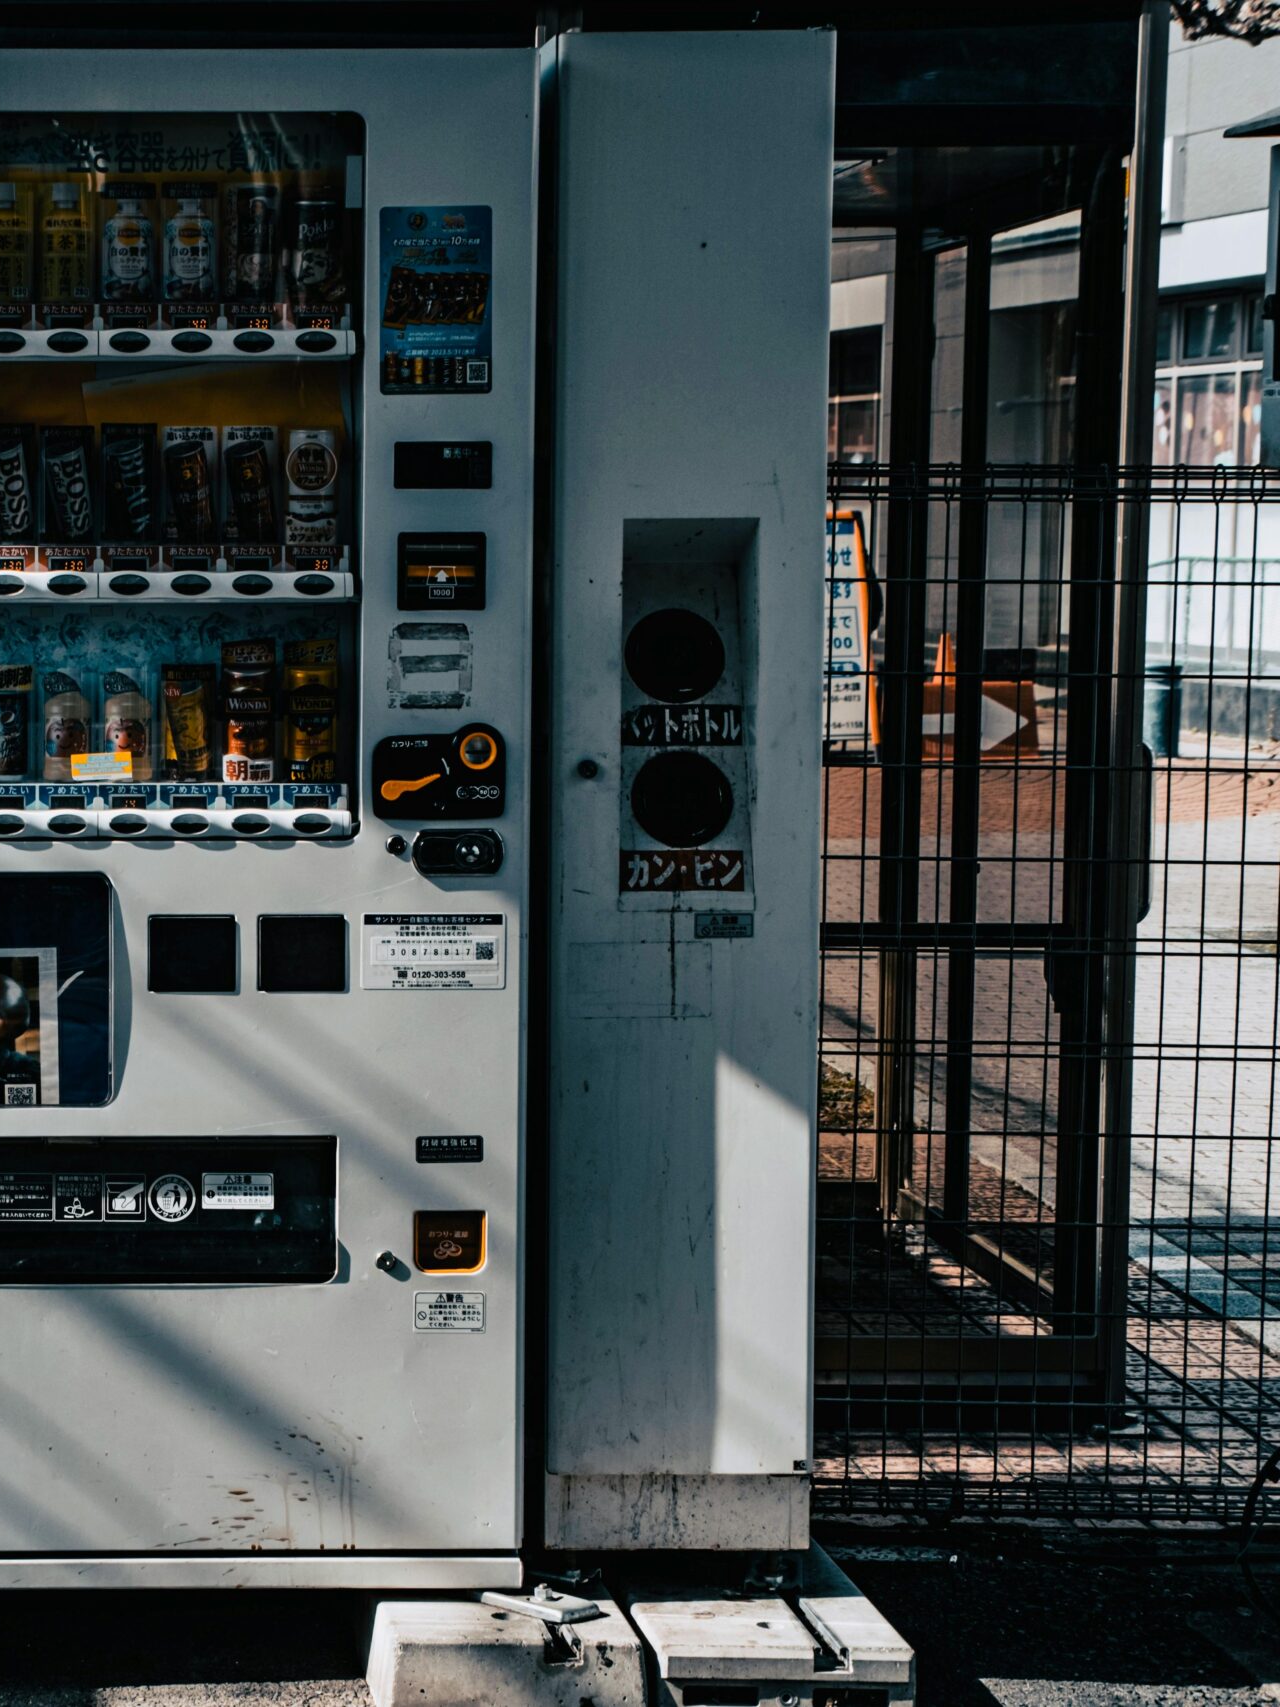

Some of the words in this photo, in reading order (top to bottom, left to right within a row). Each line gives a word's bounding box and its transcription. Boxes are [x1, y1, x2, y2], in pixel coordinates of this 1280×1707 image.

[57, 234, 74, 250] 茶
[43, 305, 87, 314] あたたかい
[107, 305, 151, 314] あたたかい
[169, 305, 214, 314] あたたかい
[231, 305, 276, 314] あたたかい
[0, 454, 31, 529] BOSS
[61, 456, 91, 531] BOSS
[45, 548, 89, 557] あたたかい
[108, 548, 152, 557] あたたかい
[170, 548, 214, 557] あたたかい
[231, 548, 275, 557] あたたかい
[292, 548, 337, 557] あたたかい
[432, 588, 452, 597] 1000
[164, 688, 182, 697] NEW
[228, 697, 268, 711] WONDA
[225, 760, 247, 782] 朝
[46, 786, 90, 795] つめたい
[108, 786, 151, 795] つめたい
[167, 786, 212, 795] つめたい
[229, 786, 273, 795] つめたい
[290, 786, 335, 795] つめたい
[627, 853, 742, 888] カン・ビン
[411, 970, 466, 979] 0120-303-558
[234, 1175, 252, 1185] 注意
[446, 1293, 465, 1304] 警告
